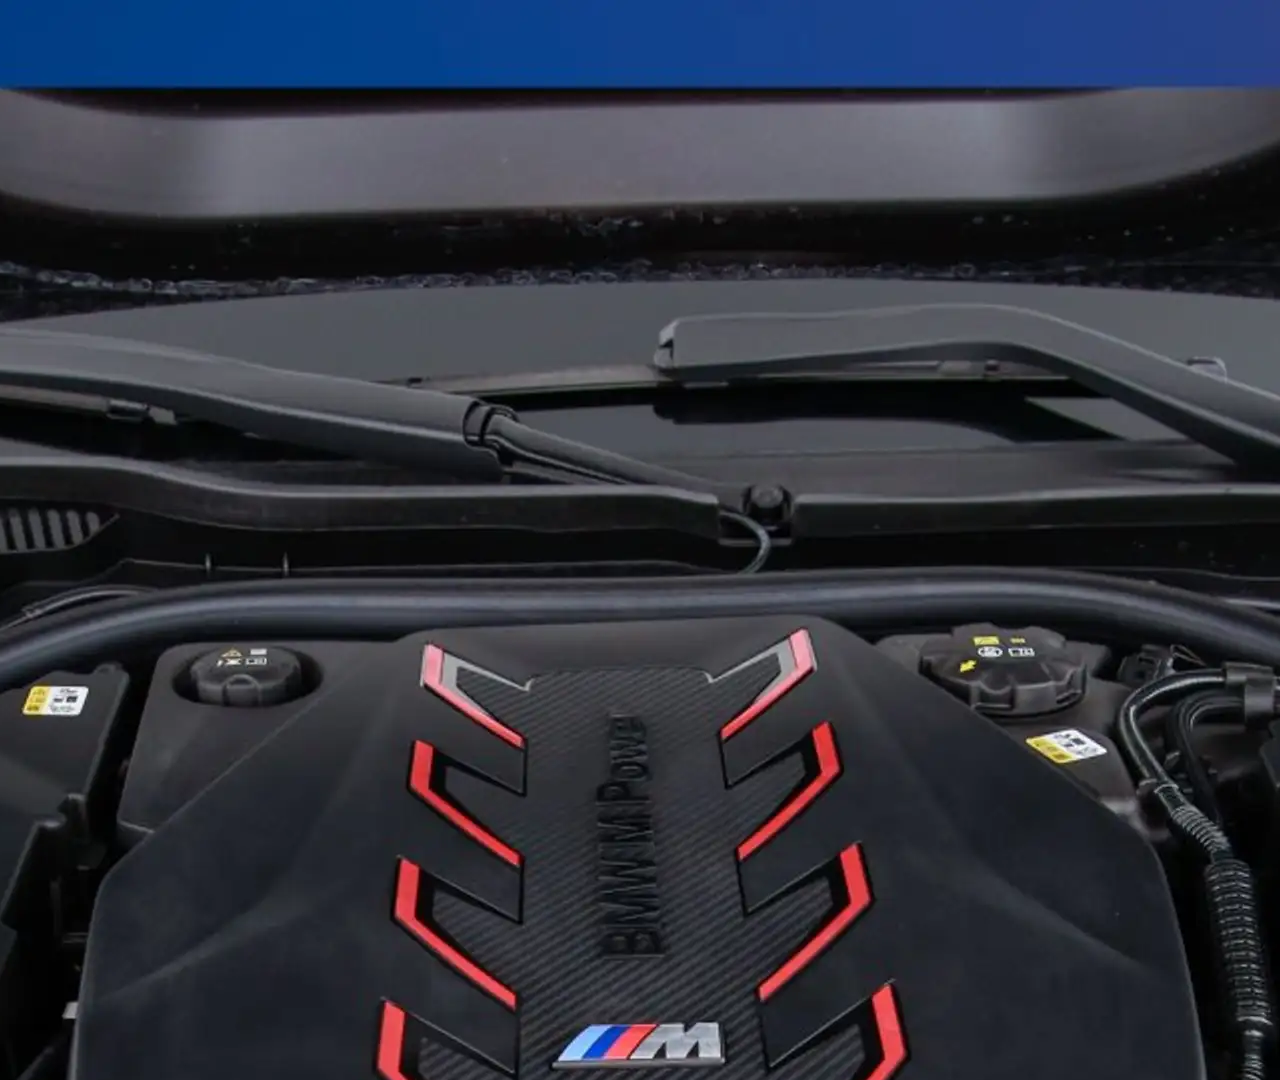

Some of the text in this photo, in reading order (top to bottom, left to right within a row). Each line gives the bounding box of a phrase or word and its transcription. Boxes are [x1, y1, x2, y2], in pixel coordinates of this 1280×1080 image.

[597, 811, 656, 847] M
[597, 859, 665, 958] BMW
[629, 1022, 722, 1060] M
